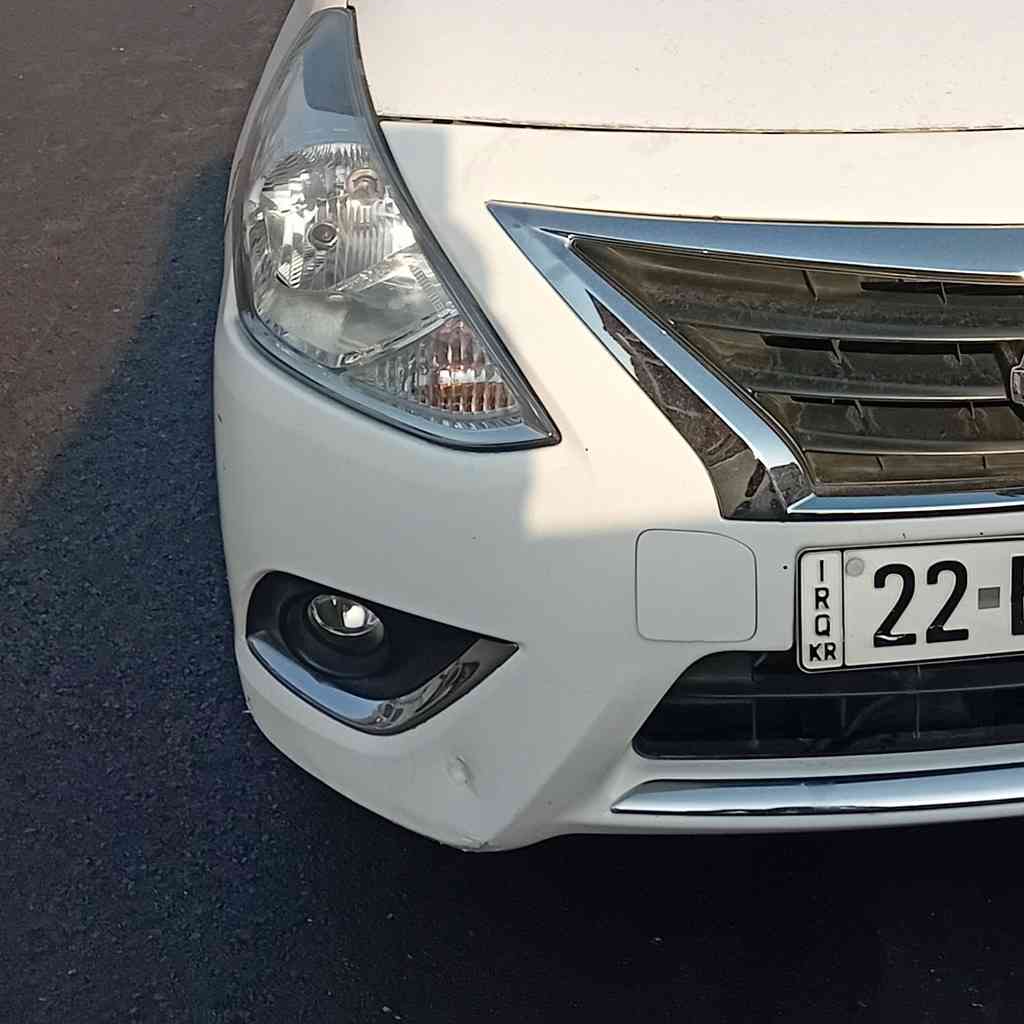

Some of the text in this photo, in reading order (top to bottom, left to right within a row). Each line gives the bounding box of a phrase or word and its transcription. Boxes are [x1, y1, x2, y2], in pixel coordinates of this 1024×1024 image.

[814, 559, 831, 637] IRQ
[873, 559, 969, 648] 22
[809, 642, 836, 662] KR
